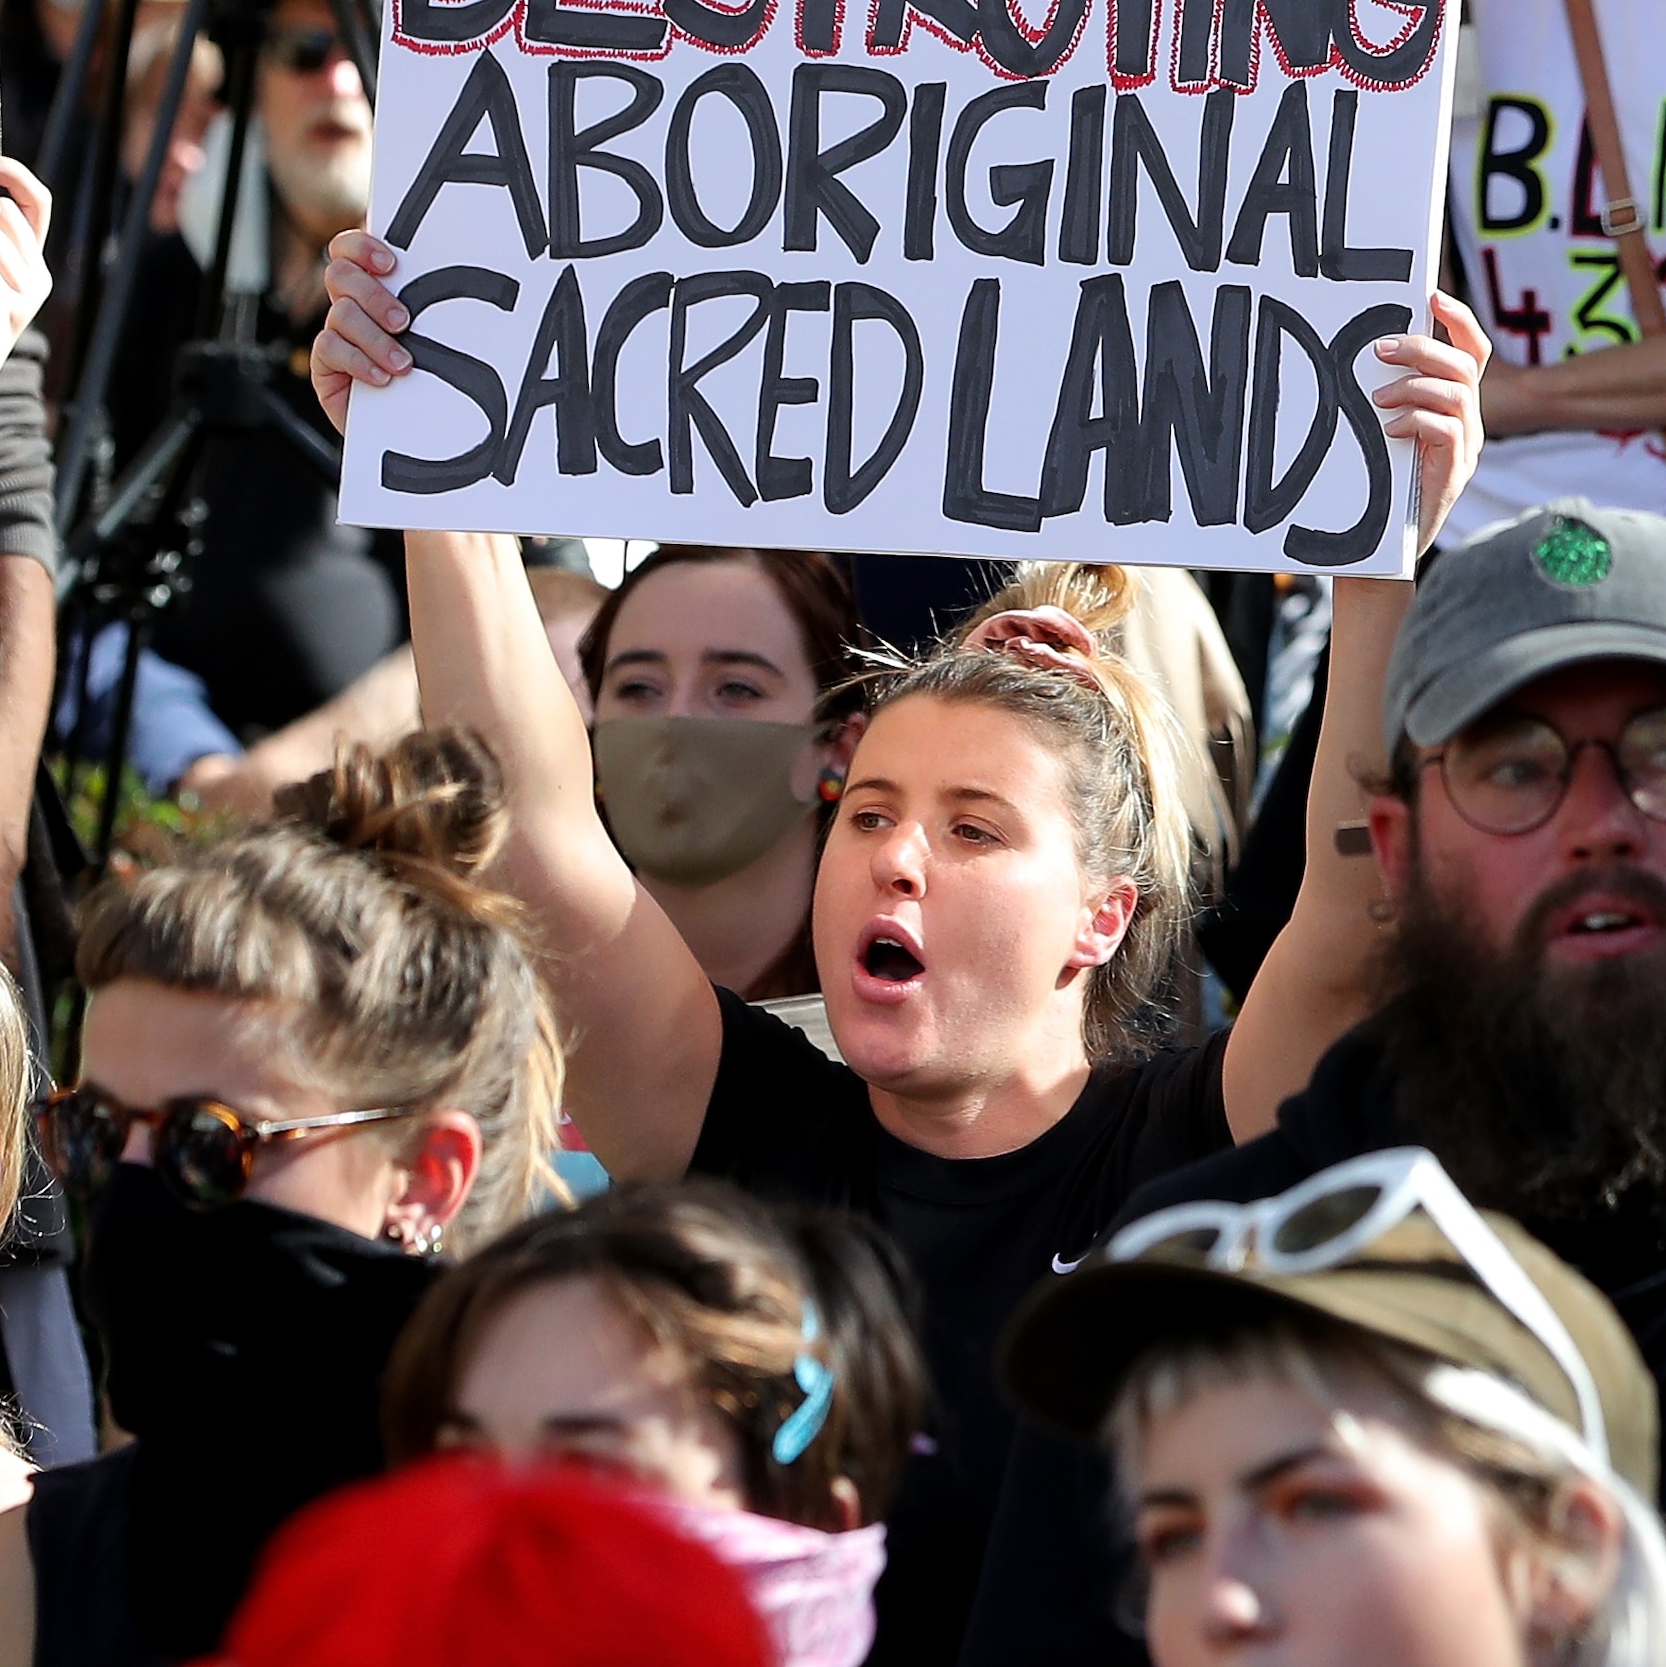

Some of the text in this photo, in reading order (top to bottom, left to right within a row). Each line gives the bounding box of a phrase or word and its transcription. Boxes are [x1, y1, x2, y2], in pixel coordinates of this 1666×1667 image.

[385, 49, 1414, 284] ABORIGINAL
[380, 265, 1414, 567] SACRED LANDS
